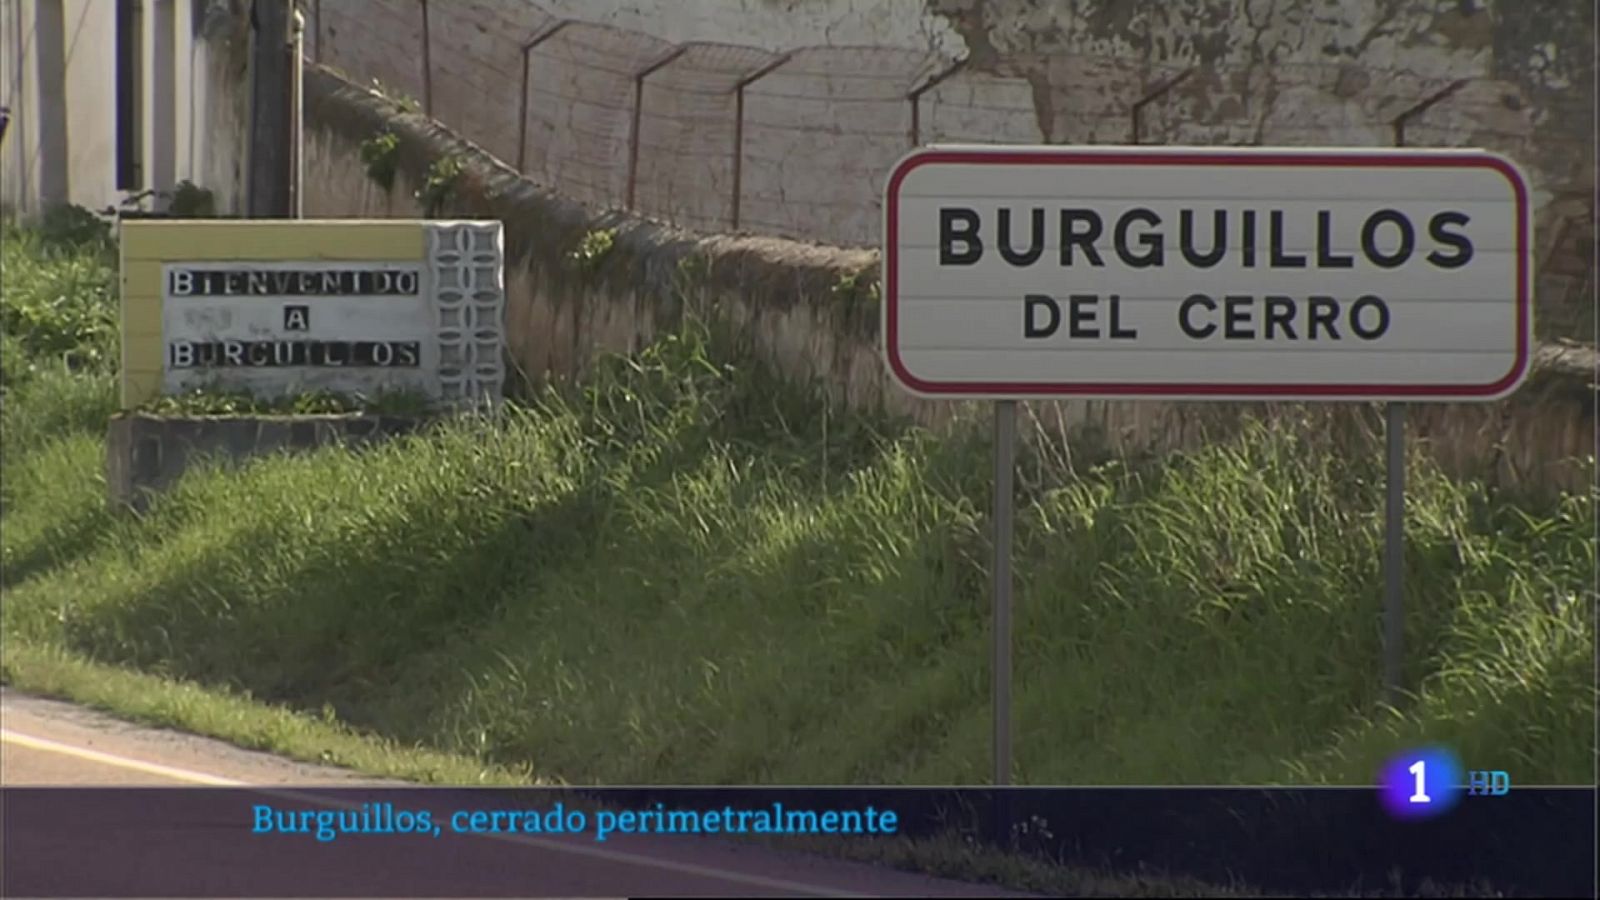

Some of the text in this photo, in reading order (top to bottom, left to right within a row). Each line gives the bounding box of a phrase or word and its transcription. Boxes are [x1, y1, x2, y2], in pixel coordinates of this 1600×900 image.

[938, 207, 1475, 269] BURGUILLOS
[172, 270, 417, 295] BIENVENIDO
[286, 308, 307, 330] A
[1023, 294, 1391, 341] DEL CERRO
